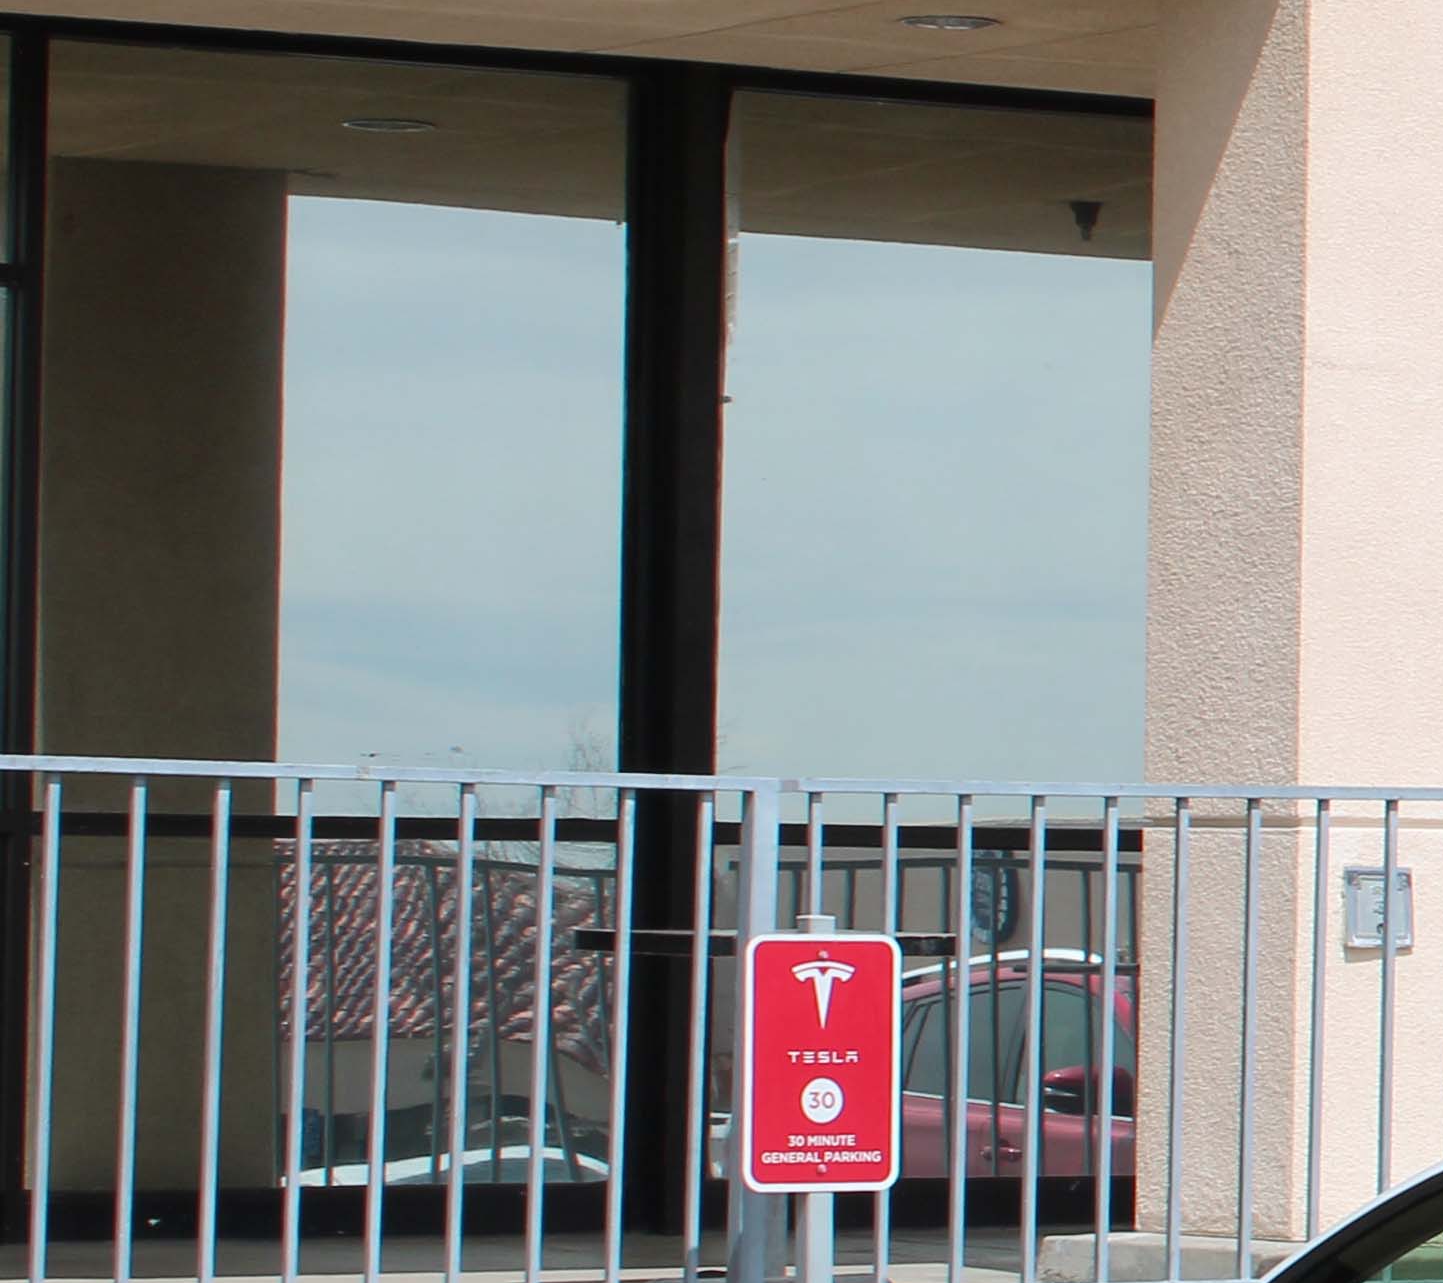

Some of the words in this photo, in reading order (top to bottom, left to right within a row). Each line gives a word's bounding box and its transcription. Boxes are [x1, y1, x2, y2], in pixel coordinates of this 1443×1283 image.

[787, 1050, 860, 1064] TESLA
[808, 1091, 836, 1110] 30
[787, 1134, 804, 1148] 30
[807, 1133, 857, 1147] MINUTE
[760, 1151, 821, 1165] GENERAL
[823, 1150, 882, 1164] PARKING
